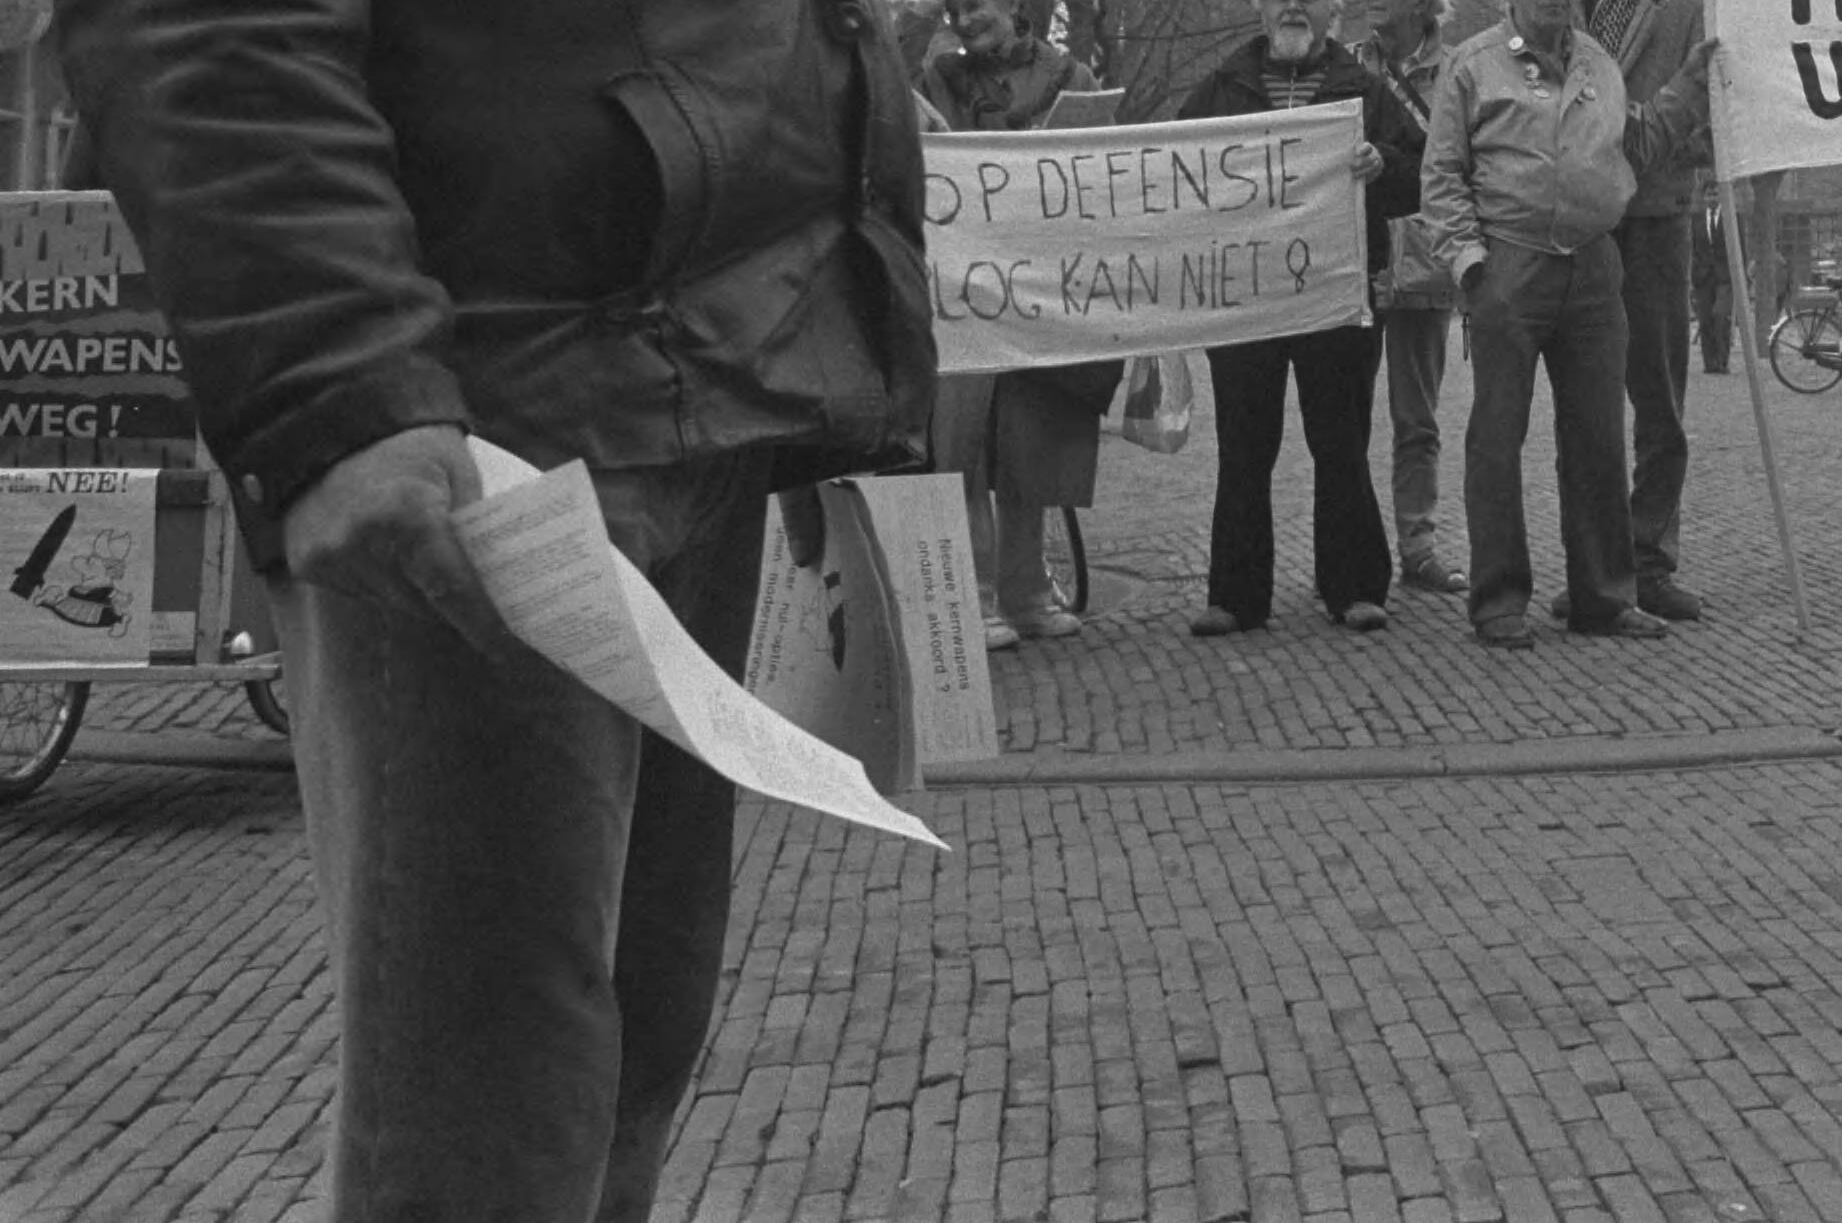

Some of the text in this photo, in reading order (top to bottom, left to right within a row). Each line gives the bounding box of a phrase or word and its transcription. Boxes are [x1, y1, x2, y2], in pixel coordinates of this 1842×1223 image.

[1038, 130, 1304, 220] DEFENSIE
[0, 274, 119, 313] KERN
[1061, 252, 1159, 316] KAN
[1178, 241, 1269, 309] NIET
[0, 338, 184, 372] WAPENS
[46, 472, 129, 493] NEE!
[918, 541, 936, 602] ondanks
[927, 613, 947, 674] akkoord
[939, 539, 971, 690] Nieuwe kernwapens
